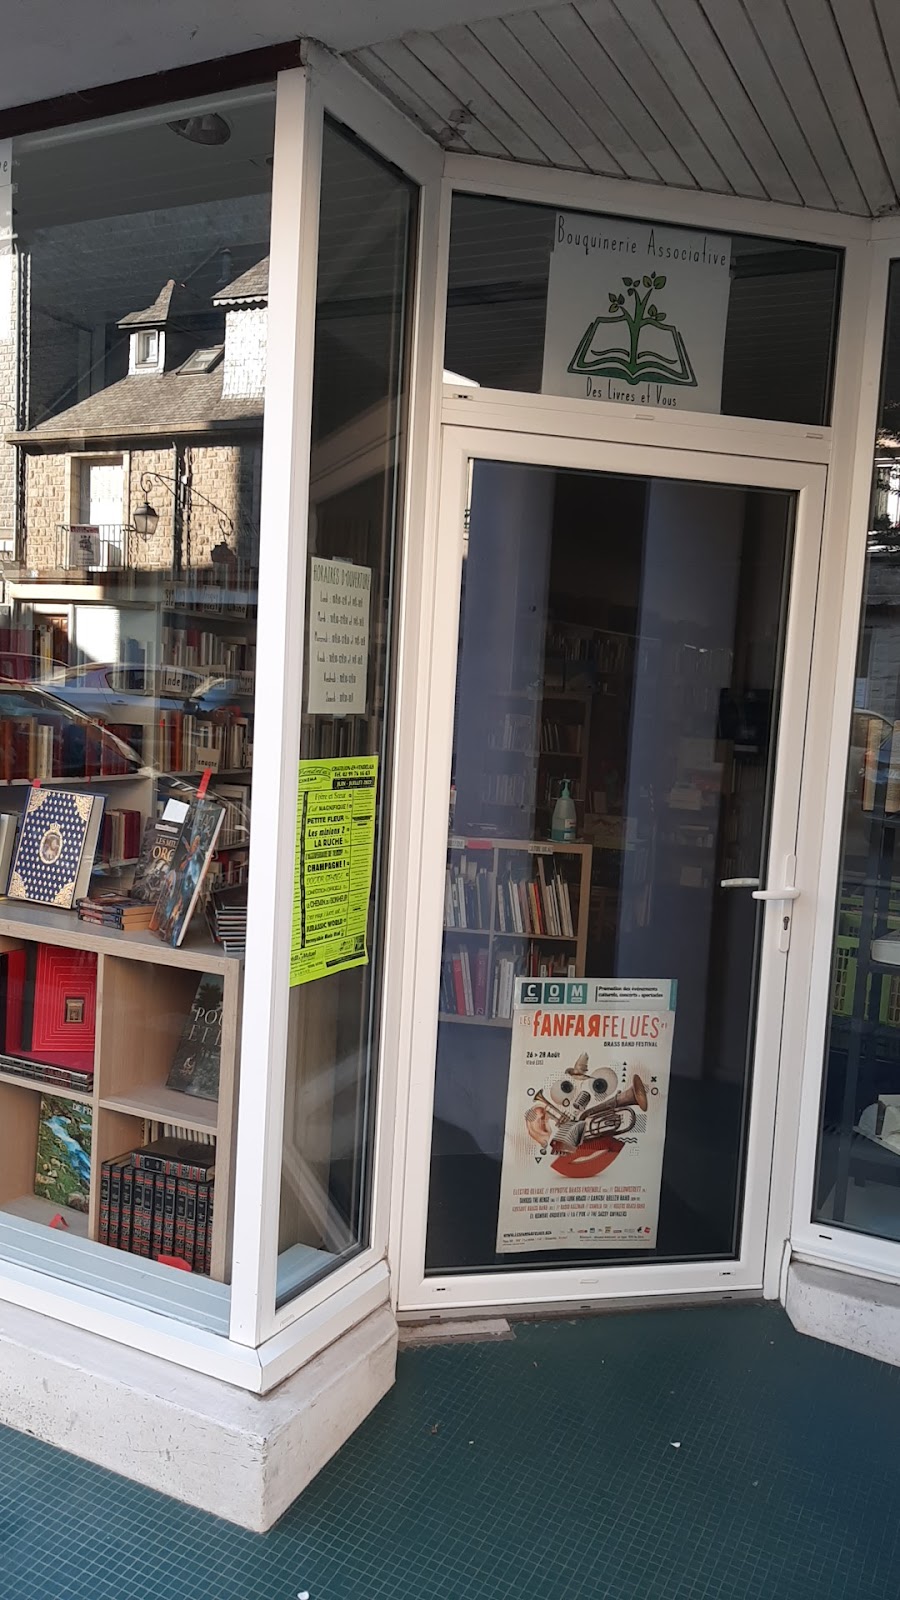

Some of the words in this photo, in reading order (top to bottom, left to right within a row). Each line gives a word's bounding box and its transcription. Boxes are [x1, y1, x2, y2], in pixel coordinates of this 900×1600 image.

[557, 215, 637, 256] Bouquinerie
[647, 229, 727, 266] Associative
[586, 377, 602, 398] Des
[608, 379, 635, 402] Livres
[640, 386, 651, 403] et
[656, 385, 677, 406] Vous
[313, 564, 340, 585] HORAIRES
[164, 668, 181, 687] Inde
[307, 816, 326, 825] PETITE
[328, 815, 345, 823] FLEUR
[308, 829, 318, 837] Les
[314, 839, 322, 848] LA
[323, 837, 343, 846] RUCHE
[307, 861, 342, 873] CHAMPAGNE
